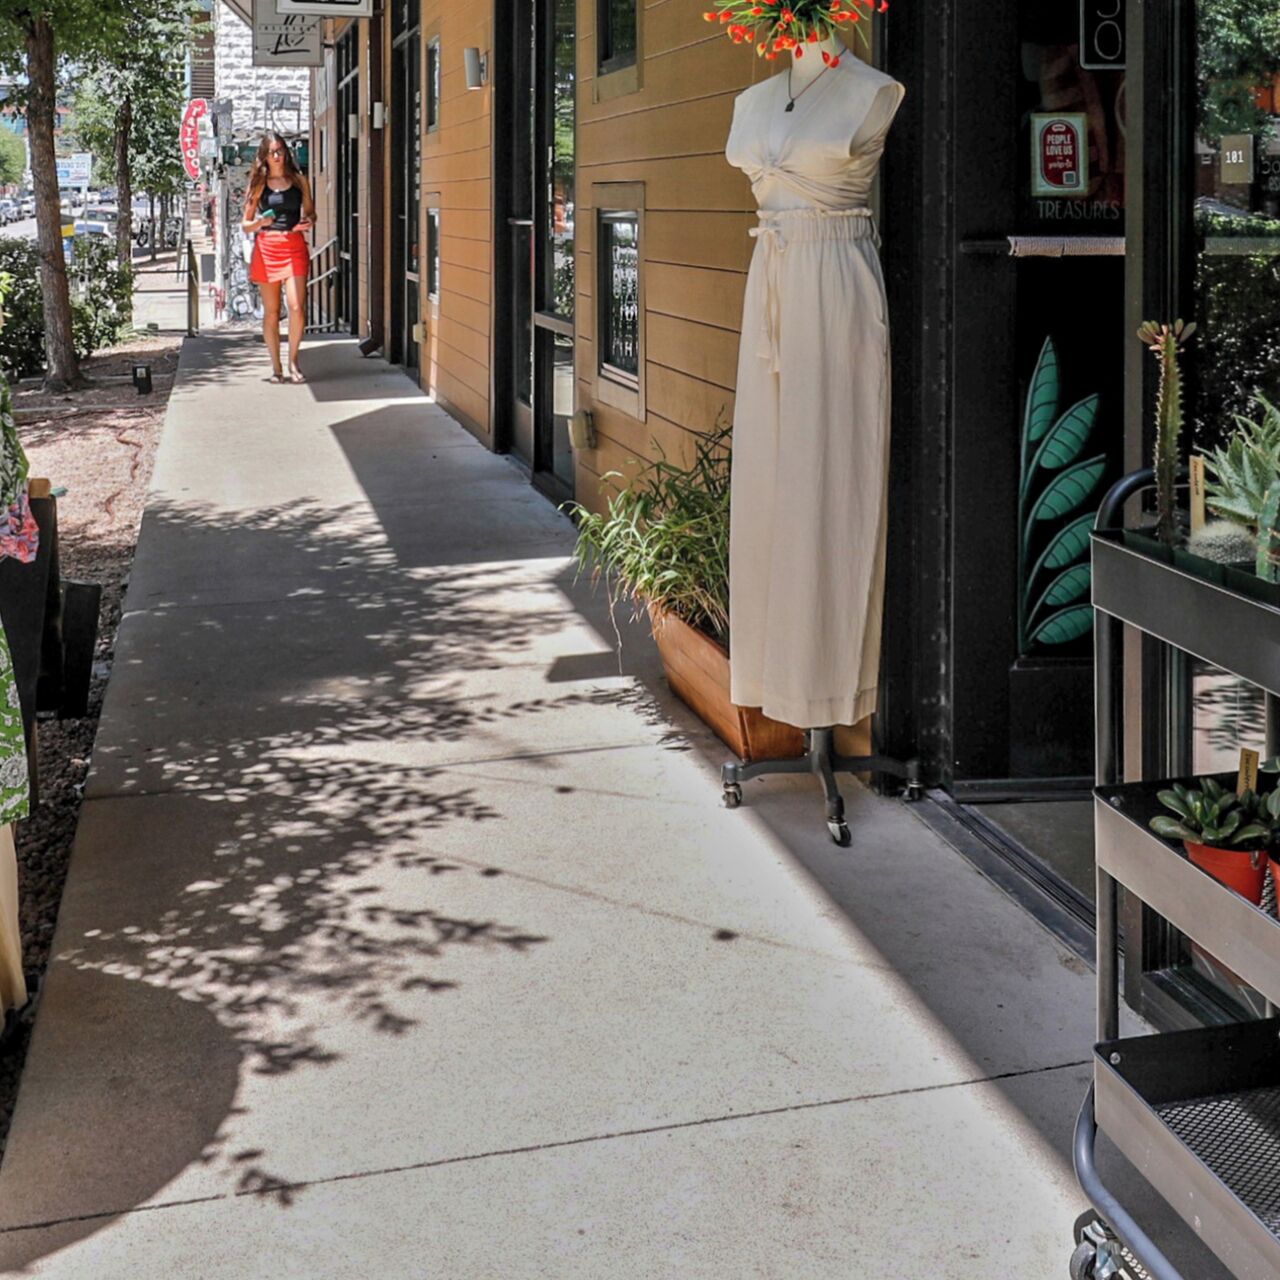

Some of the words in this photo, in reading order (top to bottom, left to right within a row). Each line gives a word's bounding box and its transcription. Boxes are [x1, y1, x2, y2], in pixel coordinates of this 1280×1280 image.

[183, 106, 202, 169] TATTOO
[1046, 134, 1072, 144] PEOPLE
[1046, 145, 1063, 156] LOVE
[1063, 145, 1073, 155] US
[1037, 200, 1121, 219] TREASURES
